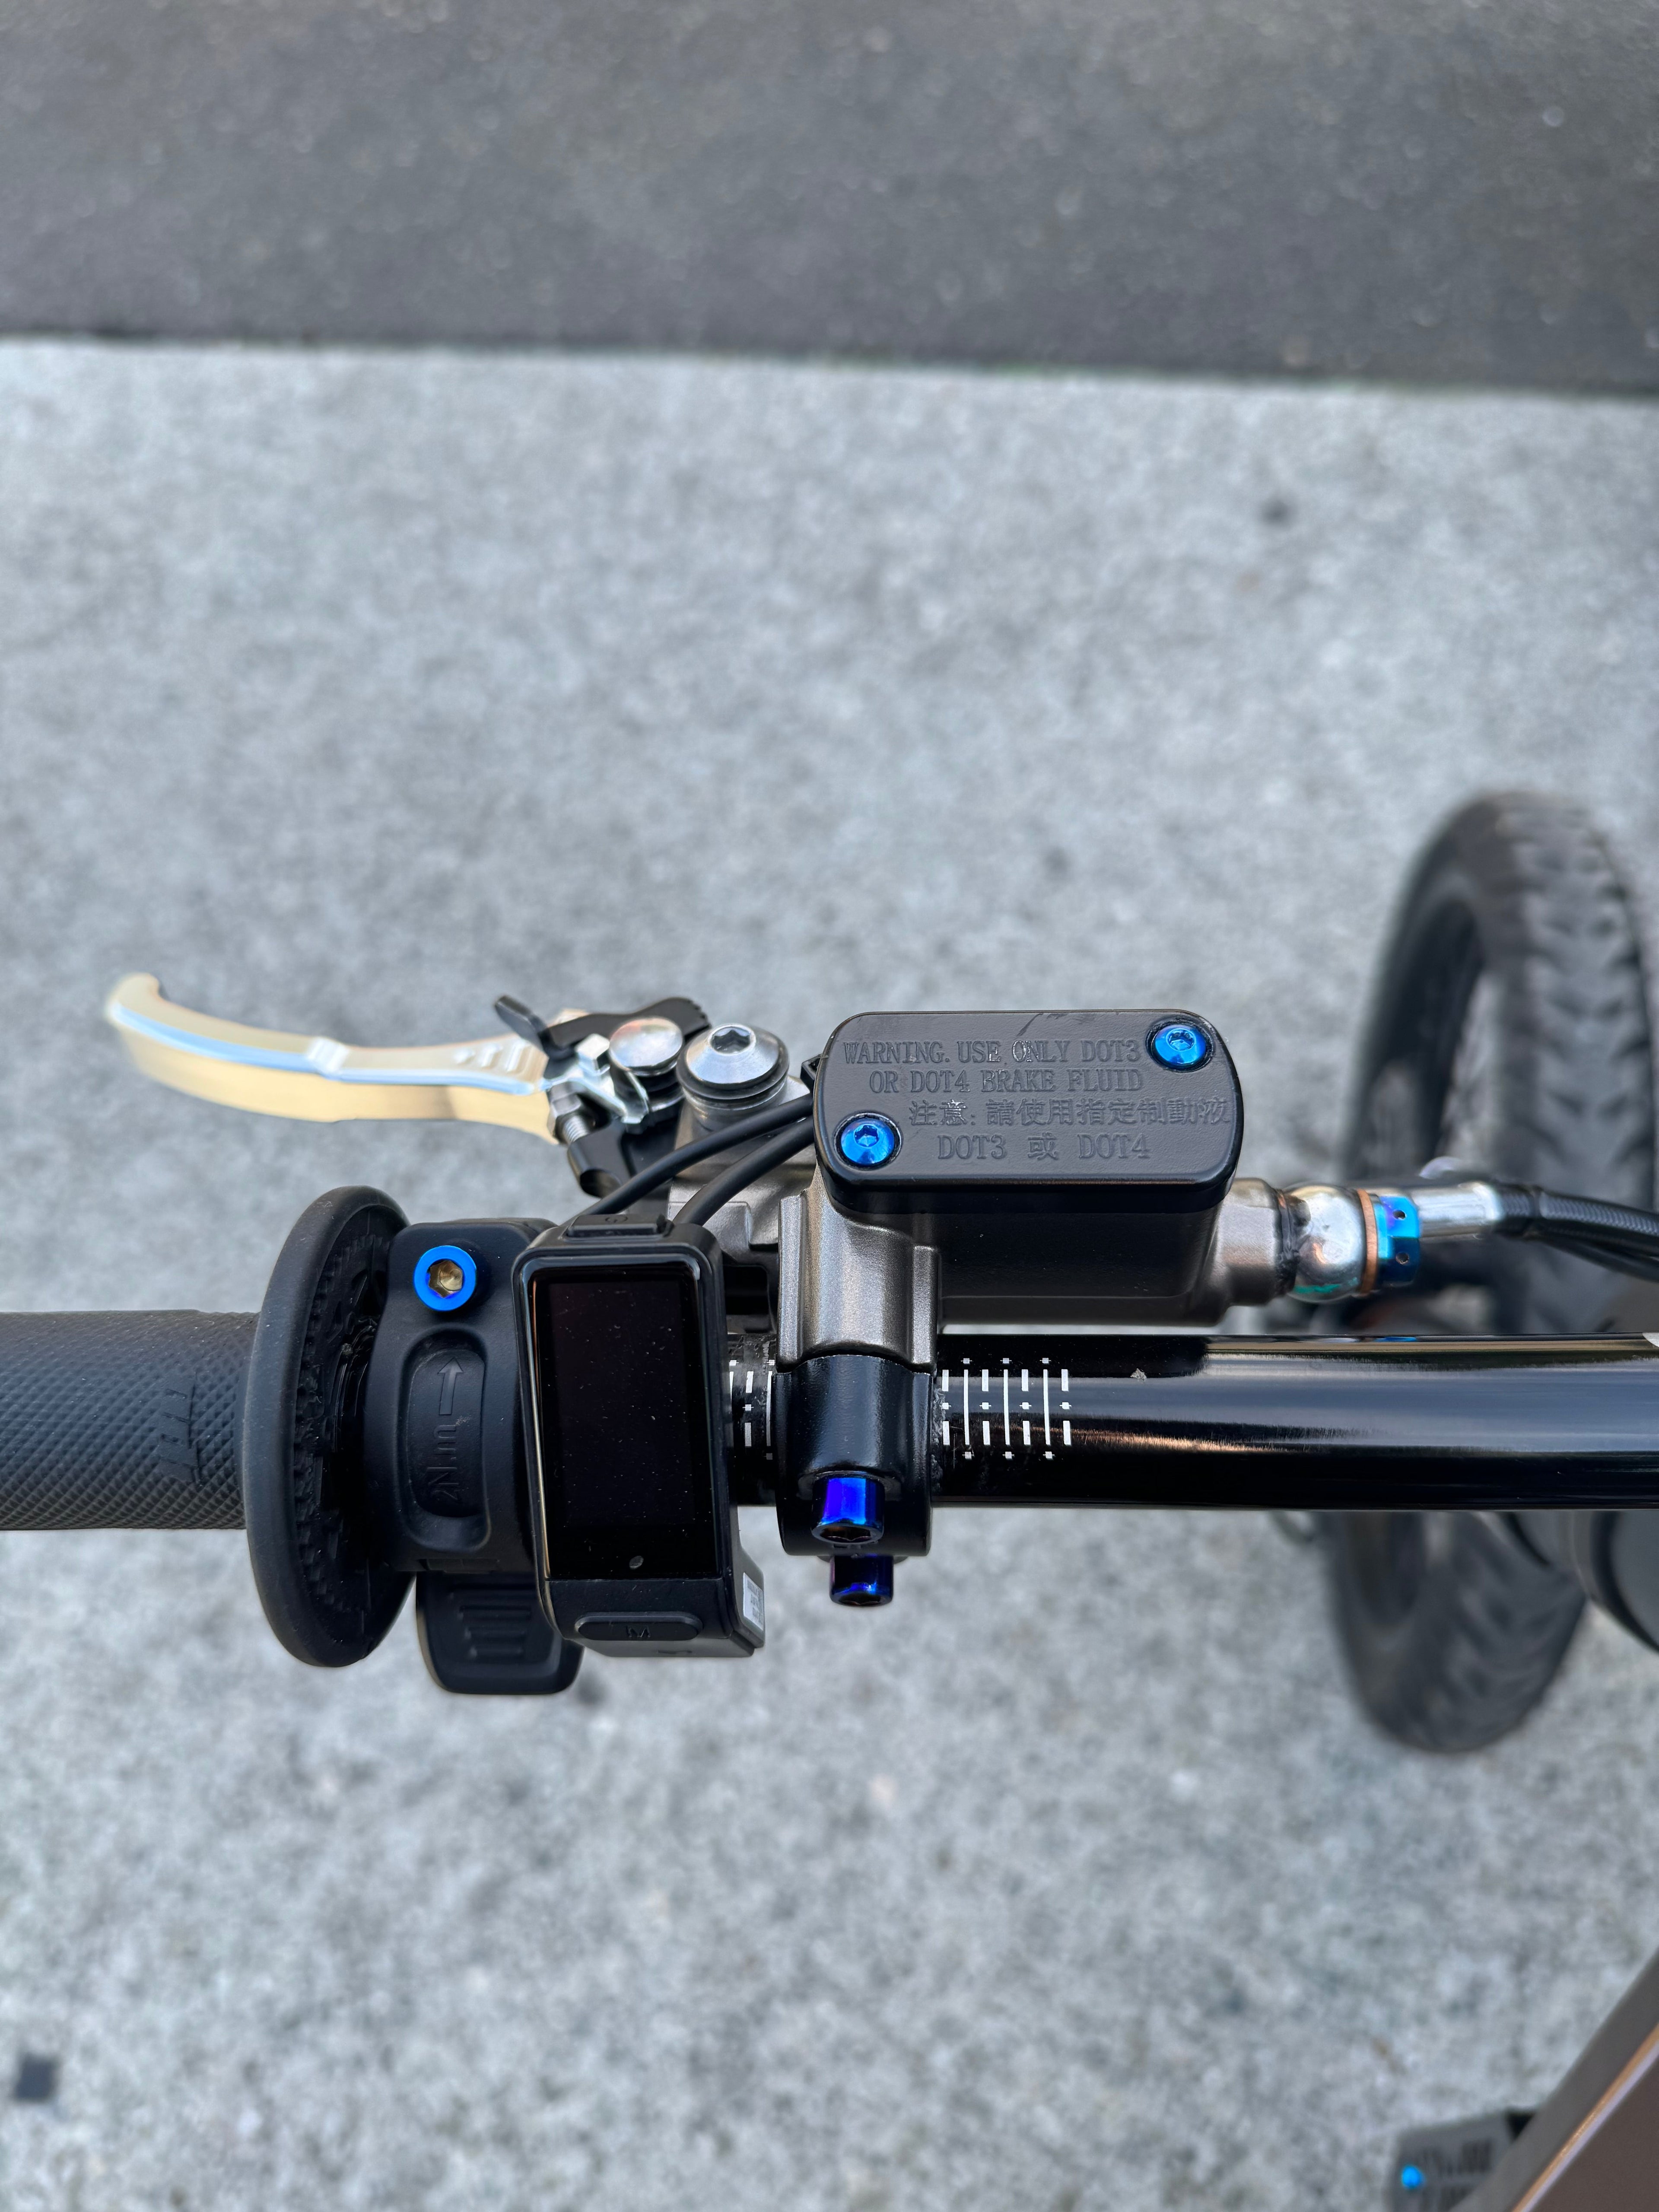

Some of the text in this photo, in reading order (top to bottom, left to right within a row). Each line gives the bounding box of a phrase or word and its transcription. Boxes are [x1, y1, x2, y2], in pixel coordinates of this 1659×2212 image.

[843, 1039, 1141, 1064] WARNING. USE ONLY DOT3
[869, 1068, 1142, 1093] OR DOT4 BRAKE FLUID
[937, 1132, 1151, 1160] DOT3 或 DOT4
